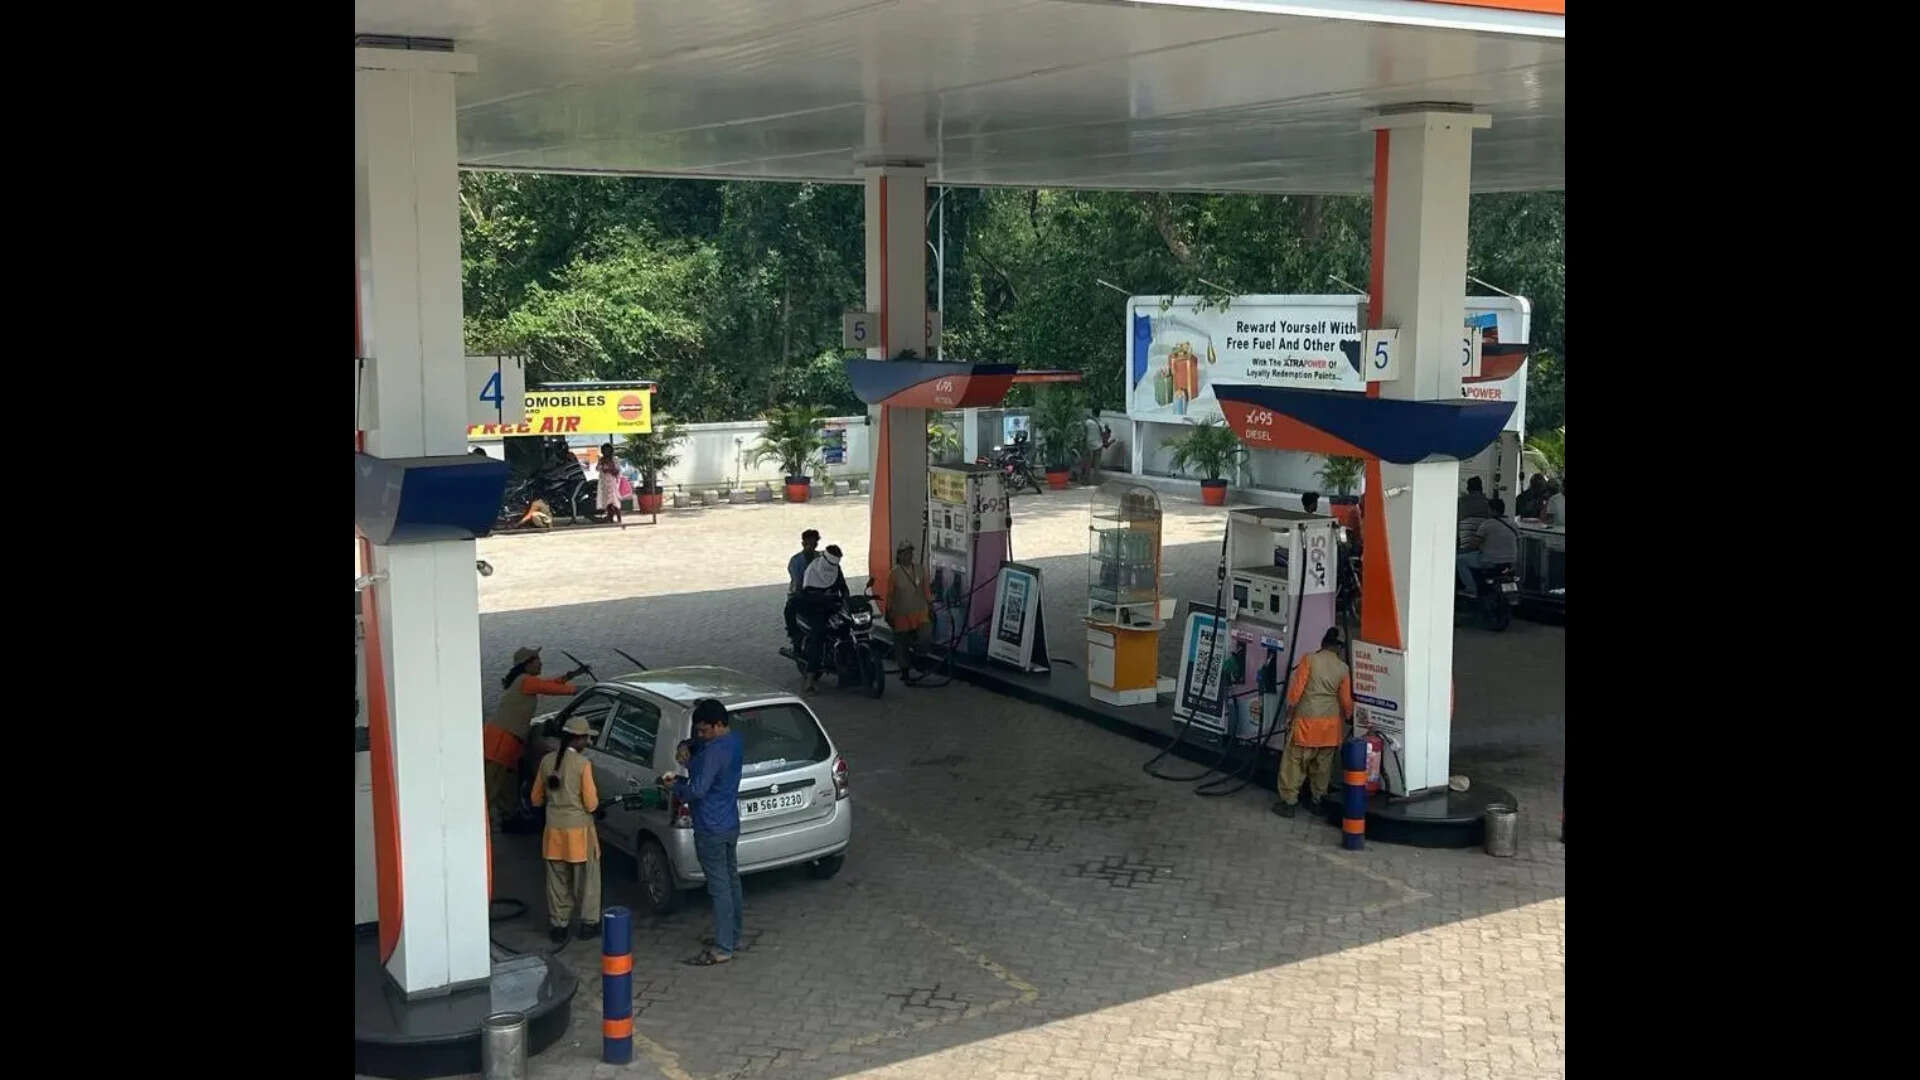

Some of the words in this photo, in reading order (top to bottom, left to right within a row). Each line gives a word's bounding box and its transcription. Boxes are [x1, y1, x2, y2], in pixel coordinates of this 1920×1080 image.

[854, 321, 866, 341] 5
[1236, 321, 1276, 333] Reward
[1280, 321, 1326, 334] Yourself
[1329, 321, 1357, 334] With
[1226, 337, 1249, 350] Free
[1253, 338, 1275, 350] Fuel
[1278, 338, 1300, 351] And
[1303, 338, 1335, 352] Other
[1252, 358, 1267, 366] With
[1269, 358, 1281, 366] The
[1374, 341, 1388, 369] 5
[1246, 369, 1271, 379] Loyalty
[1272, 370, 1313, 380] Redemption
[479, 372, 504, 409] 4
[524, 395, 606, 408] OMOBILES
[467, 417, 532, 435] FREE
[539, 416, 581, 434] AIR
[1309, 535, 1326, 588] XP95
[746, 801, 759, 813] WB
[760, 797, 778, 810] 56G
